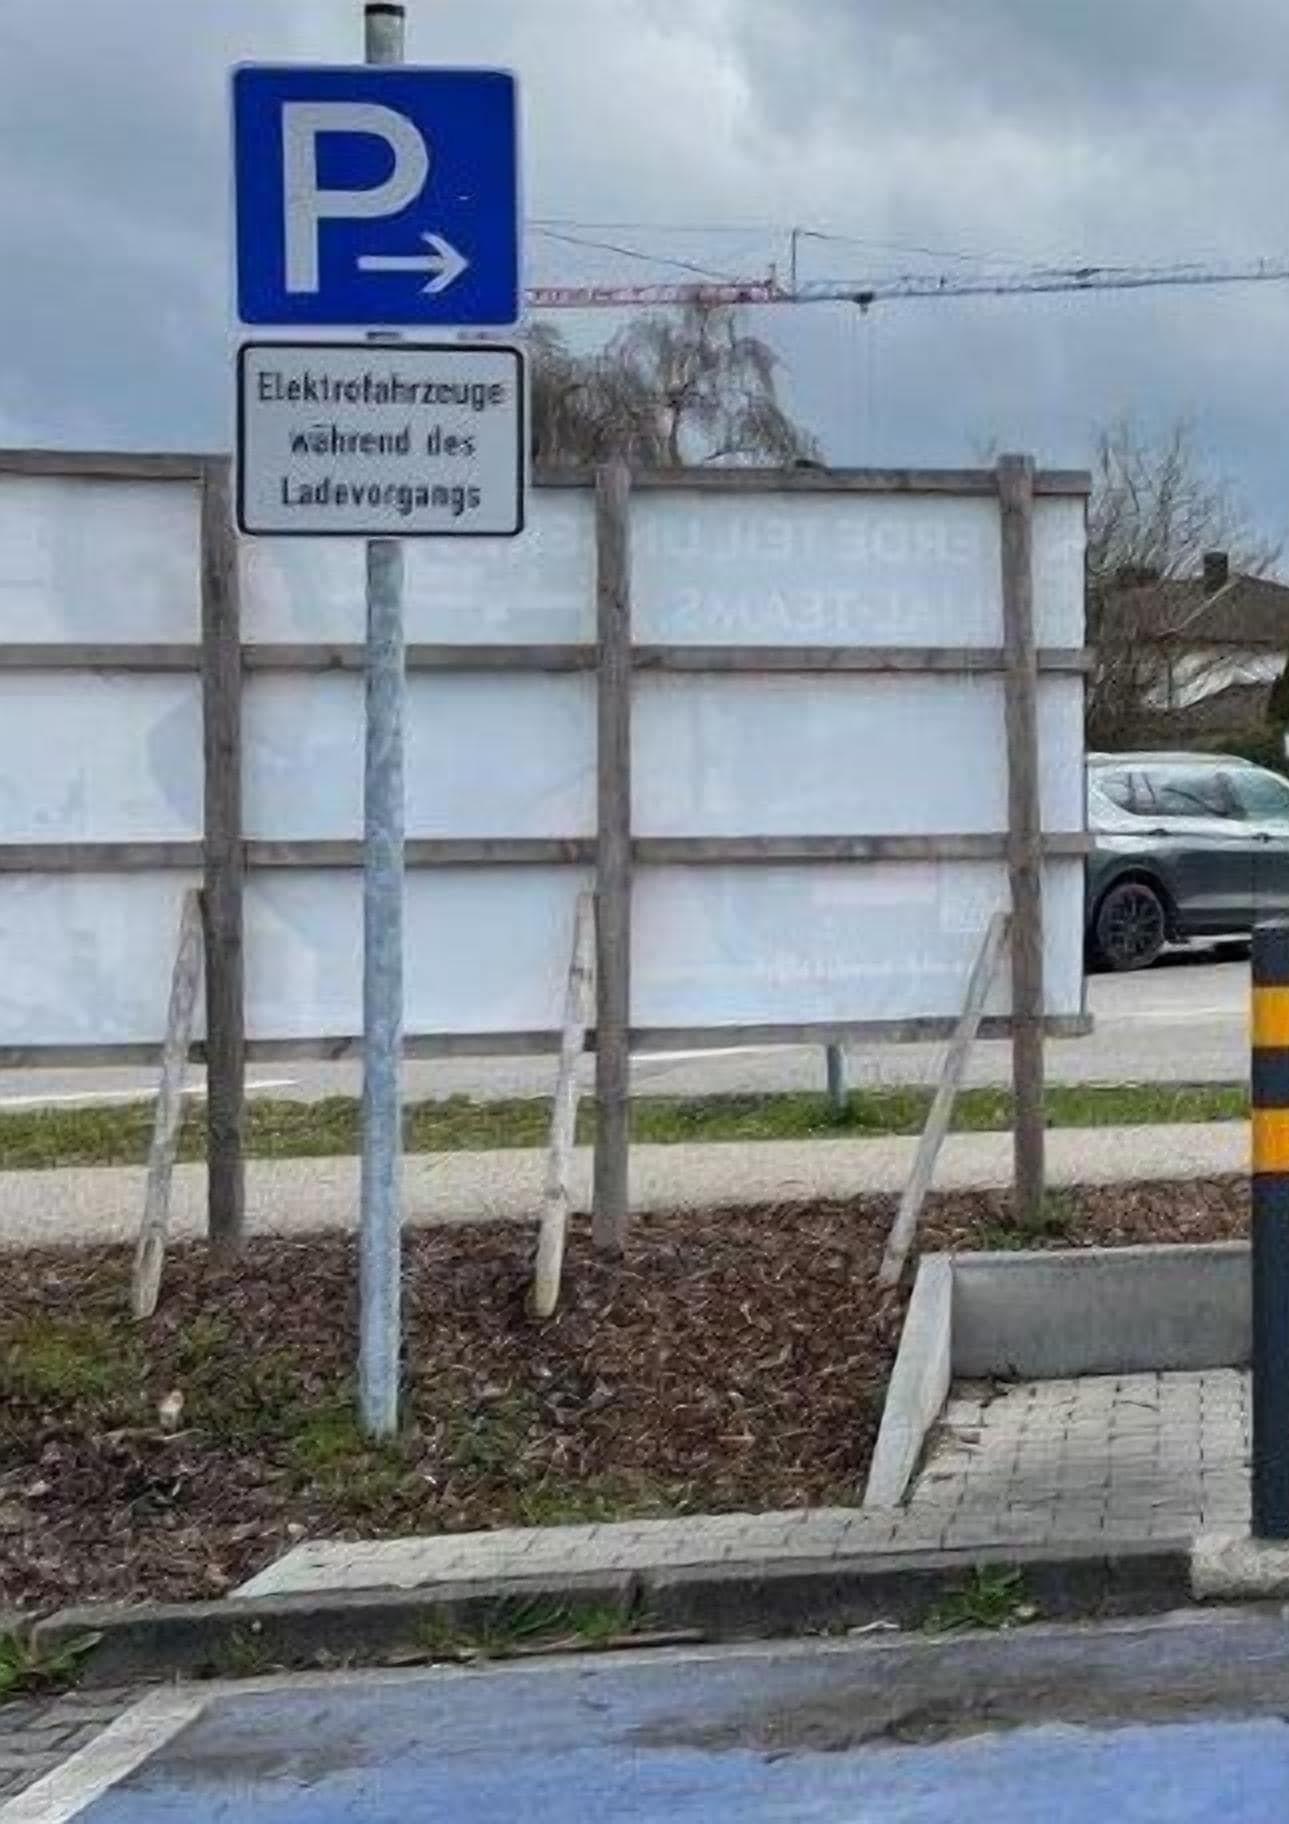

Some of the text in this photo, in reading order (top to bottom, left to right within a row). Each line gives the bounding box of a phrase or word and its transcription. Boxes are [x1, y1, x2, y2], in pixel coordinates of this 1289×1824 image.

[281, 100, 430, 294] P
[257, 371, 504, 412] Elektrofahrzeuge
[288, 423, 476, 456] während des
[281, 476, 482, 517] Ladevorgangs
